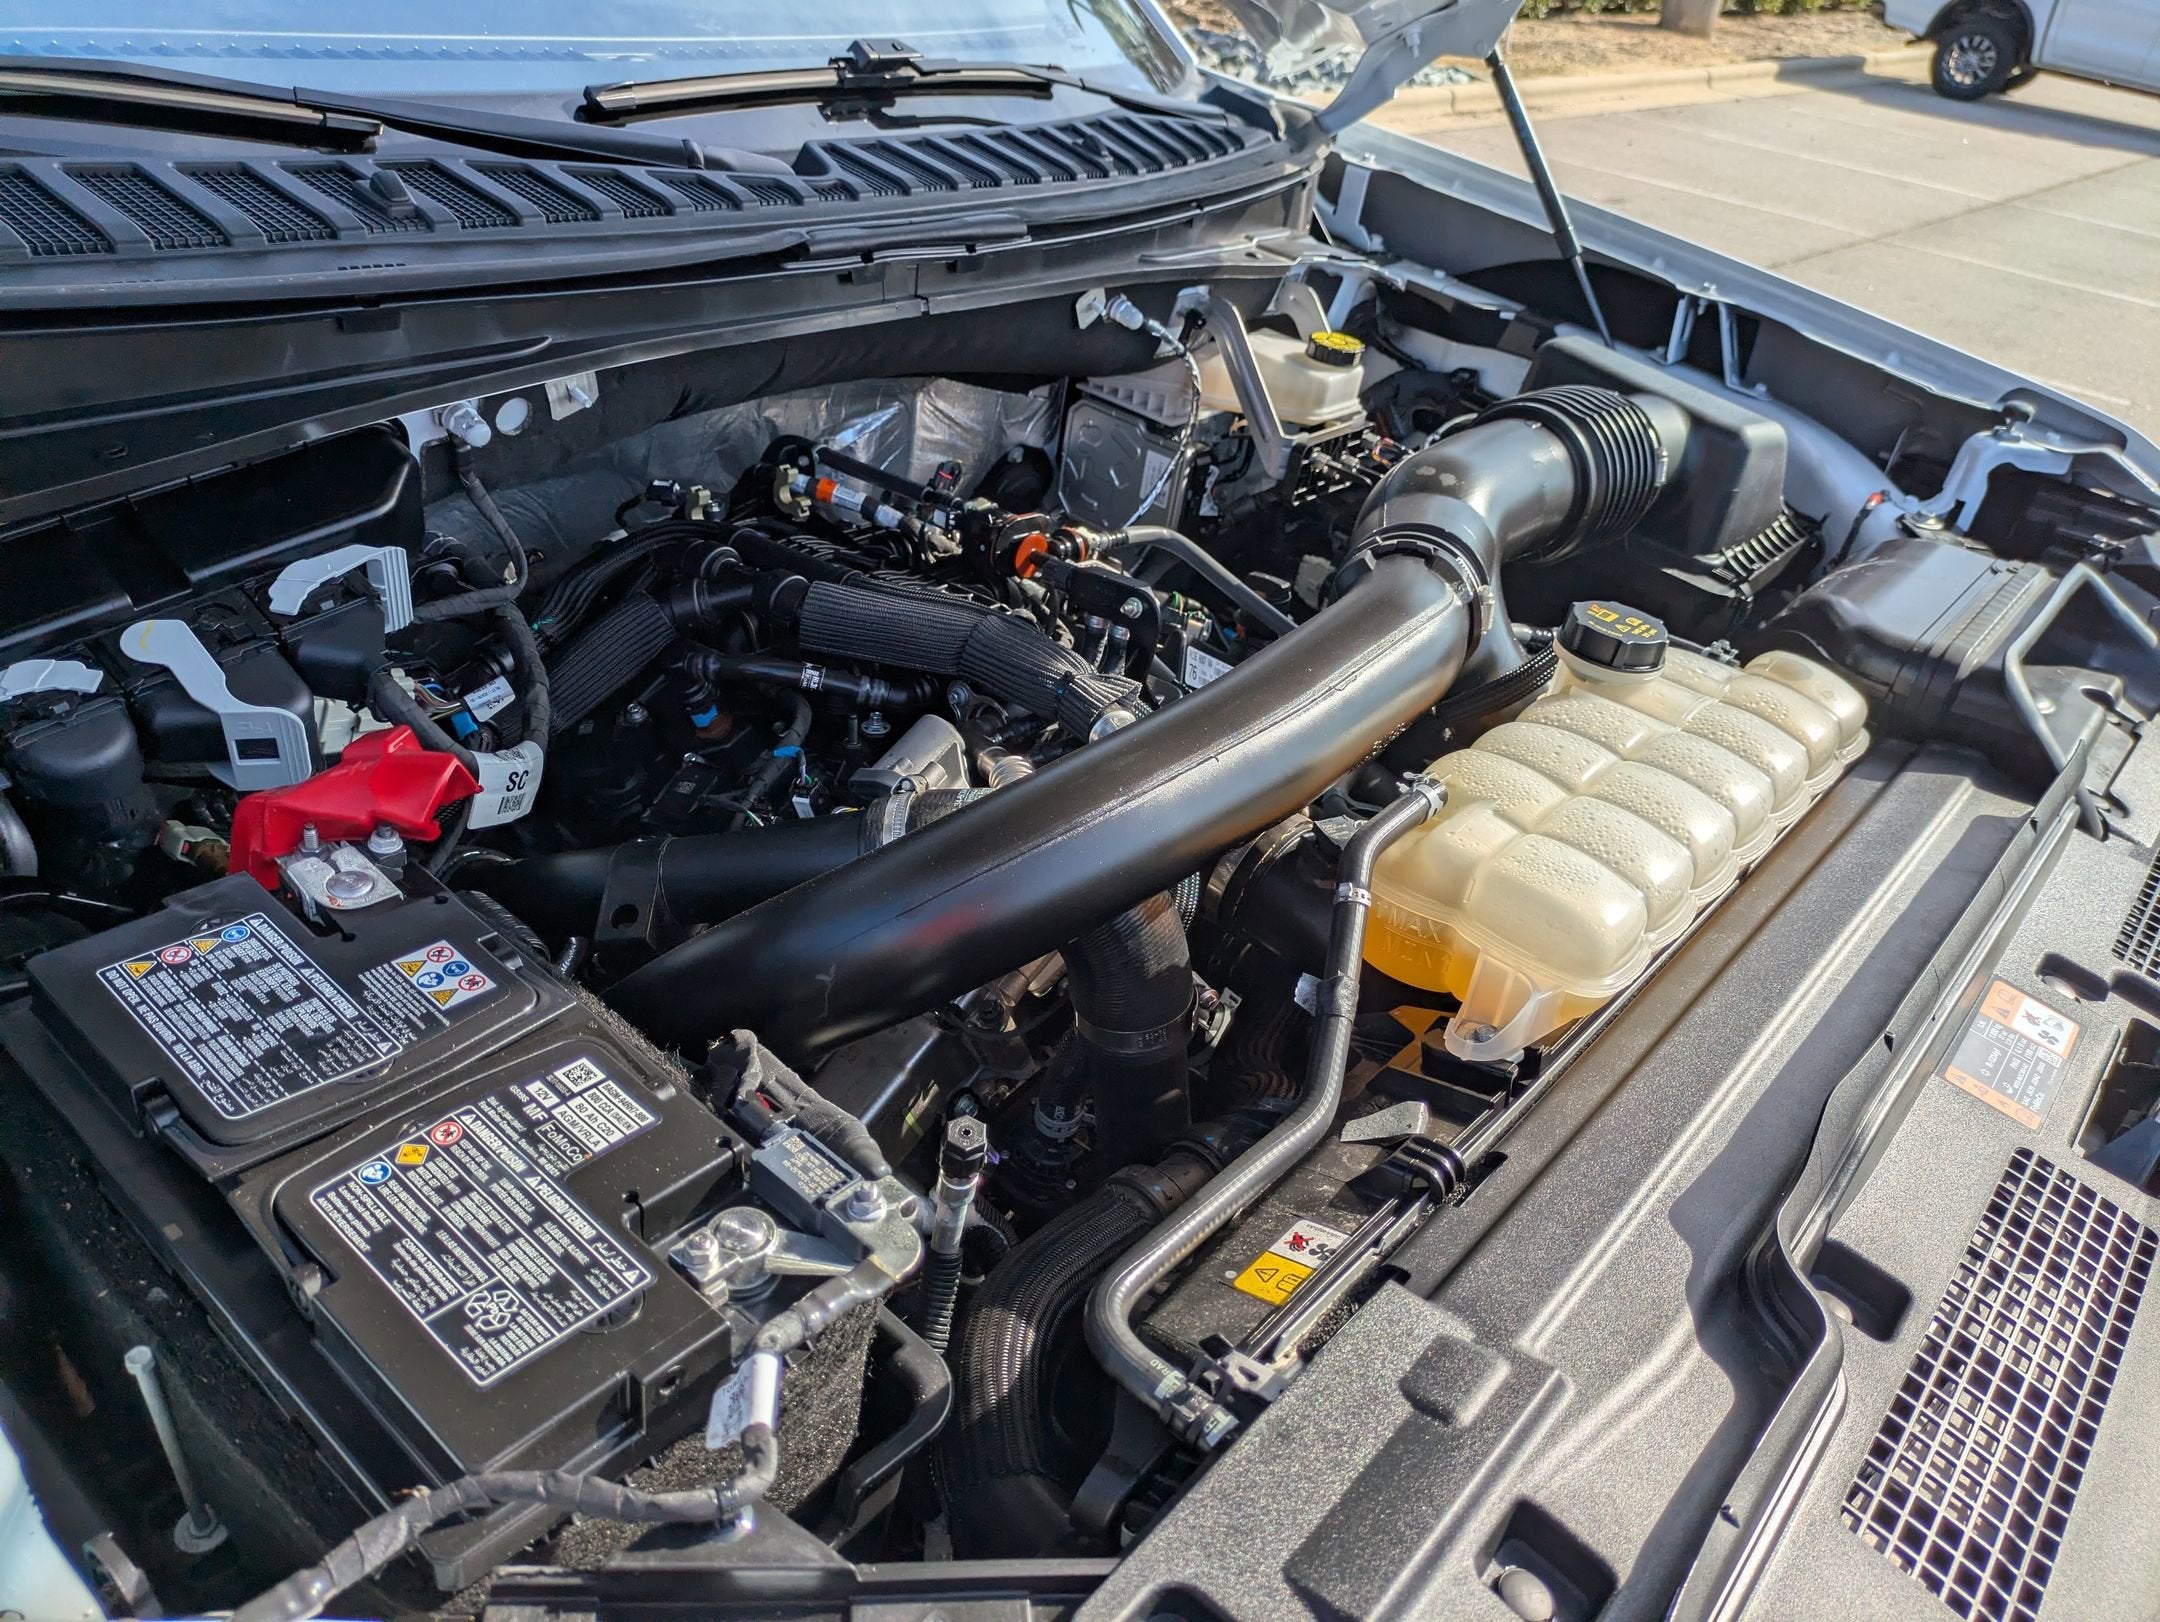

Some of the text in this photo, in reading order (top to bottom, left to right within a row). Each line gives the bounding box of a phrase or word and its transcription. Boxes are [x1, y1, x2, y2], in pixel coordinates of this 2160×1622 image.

[506, 770, 529, 792] SC
[255, 923, 305, 965] DANGER/POISON
[1387, 908, 1441, 943] MAX
[104, 969, 144, 1005] DO NOT OPEN.
[306, 973, 360, 1018] PELIGRO/VENENO
[135, 1004, 179, 1044] NE PAS OUVRIR.
[171, 1043, 209, 1078] NO LA ABRA.
[521, 1102, 549, 1123] MF
[532, 1086, 552, 1101] 12V
[586, 1091, 603, 1104] 800
[597, 1101, 615, 1114] CCA
[601, 1082, 649, 1123] BAGM-94RH7-800
[556, 1109, 601, 1148] AGM/VRLA
[573, 1102, 615, 1137] 80 Ah C20
[467, 1119, 528, 1173] DANGER/POISON
[540, 1123, 586, 1162] FoMoCo
[347, 1180, 392, 1226] NON-SPILLABLE
[377, 1184, 392, 1197] LIRE
[386, 1193, 399, 1204] LES
[386, 1179, 403, 1193] READ
[316, 1196, 371, 1253] ANTI DÉVERSEMENT
[326, 1191, 372, 1239] Batterie au plomb
[337, 1185, 384, 1233] Lead Acid Battery
[533, 1182, 597, 1240] PELIGRO/VENENO
[401, 1237, 458, 1296] CONTRA DERRAMES
[485, 1301, 501, 1315] Pb
[1150, 1359, 1170, 1375] RAD
